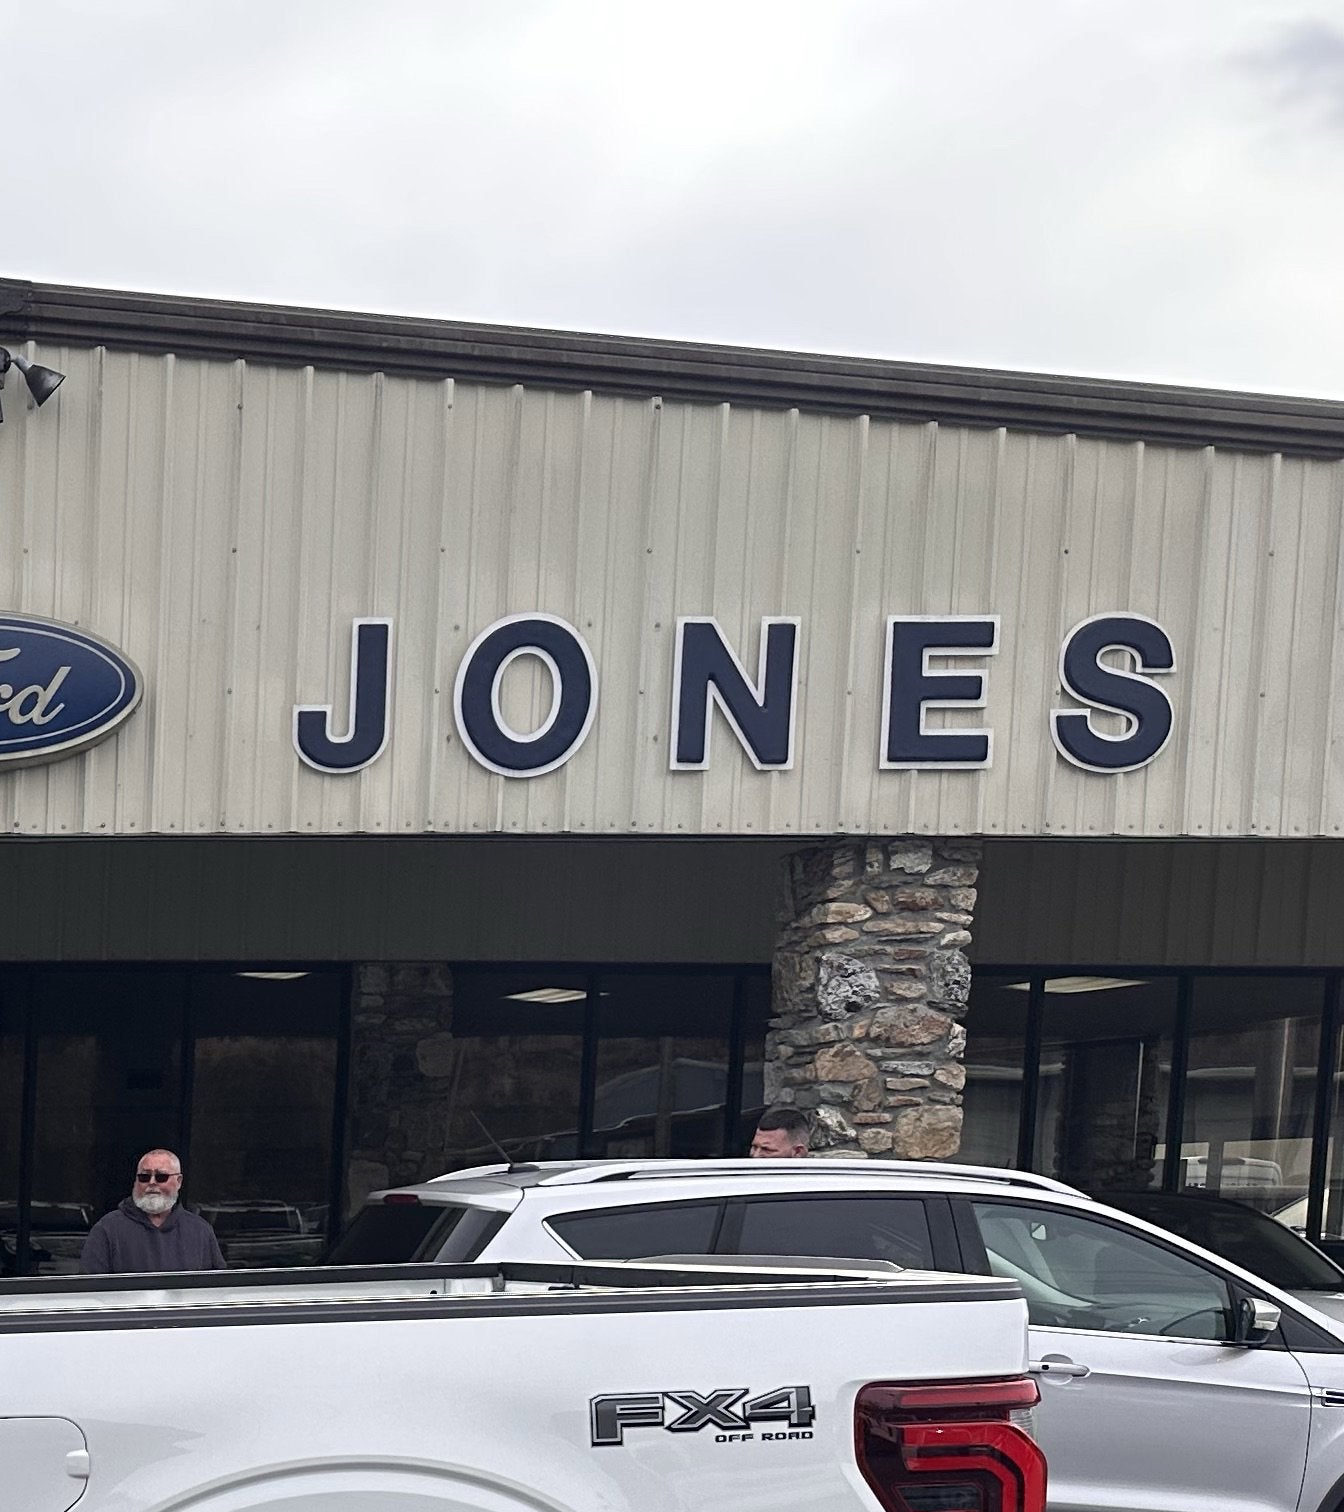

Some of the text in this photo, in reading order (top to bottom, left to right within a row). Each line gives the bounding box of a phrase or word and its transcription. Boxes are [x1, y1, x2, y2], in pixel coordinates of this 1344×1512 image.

[293, 611, 1177, 776] JONES
[589, 1385, 816, 1448] FX4
[715, 1431, 814, 1443] OFF ROAD
